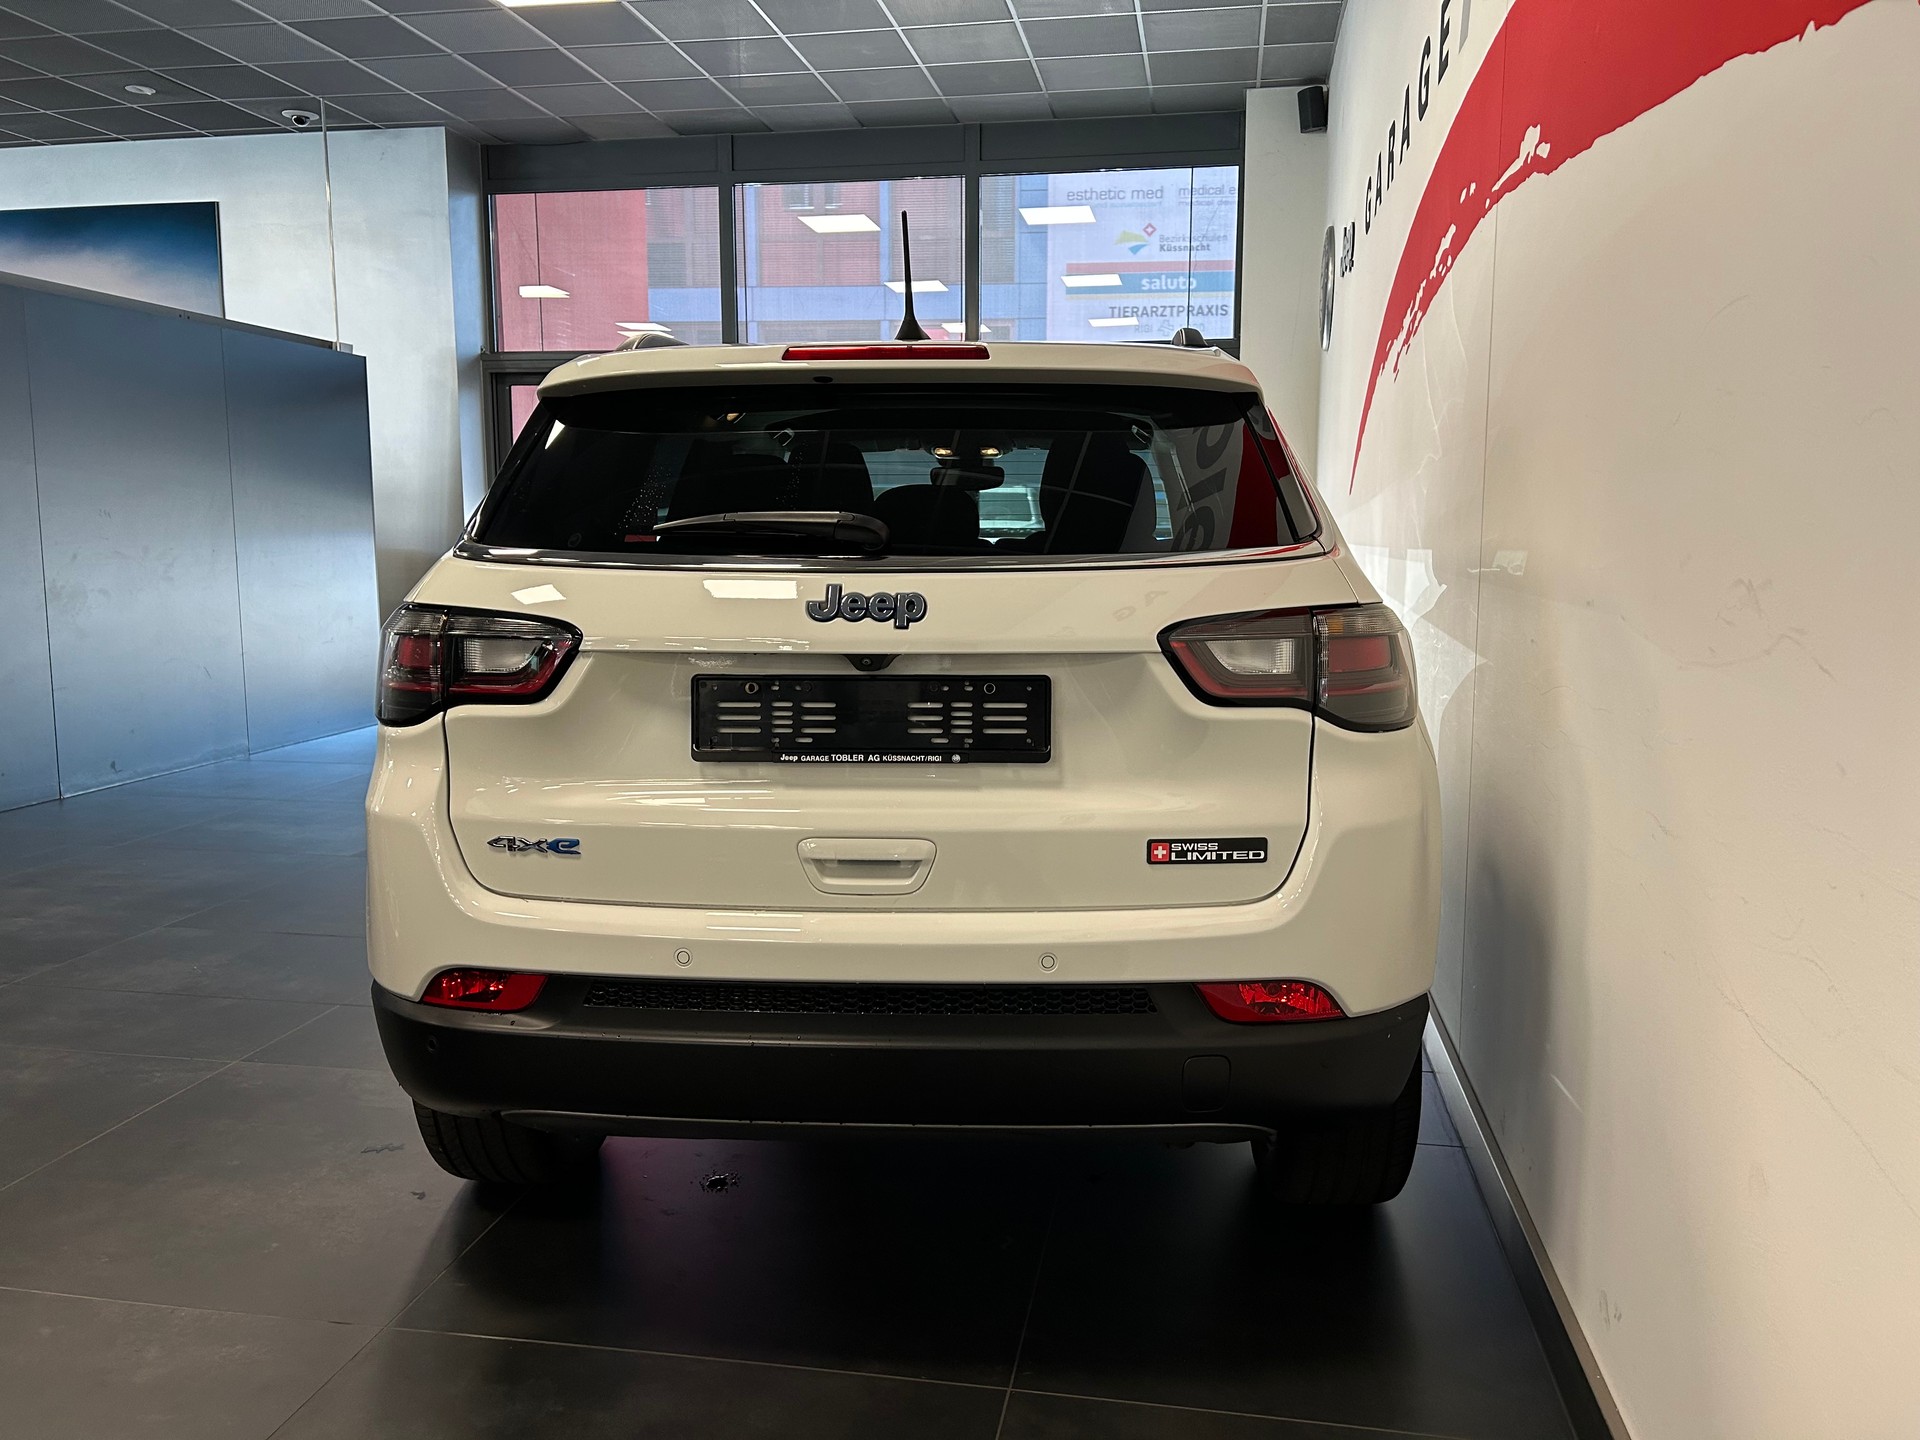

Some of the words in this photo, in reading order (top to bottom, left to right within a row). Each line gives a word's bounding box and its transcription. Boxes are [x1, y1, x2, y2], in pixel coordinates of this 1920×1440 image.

[1365, 0, 1450, 235] GARAGE
[1066, 187, 1125, 201] esthetic
[1131, 185, 1164, 200] med
[1178, 184, 1224, 196] medical
[1159, 242, 1211, 252] Küssnacht
[1141, 275, 1197, 291] saluto
[1108, 304, 1229, 319] TIERARZTPRAXIS
[805, 583, 928, 630] Jeep
[780, 754, 798, 762] Jeep
[831, 754, 864, 762] TOBLER
[867, 754, 880, 762] AG
[882, 753, 942, 762] KÜSSNACHT/RIGI
[1171, 842, 1219, 851] SWISS
[1171, 850, 1265, 861] LIMITED
